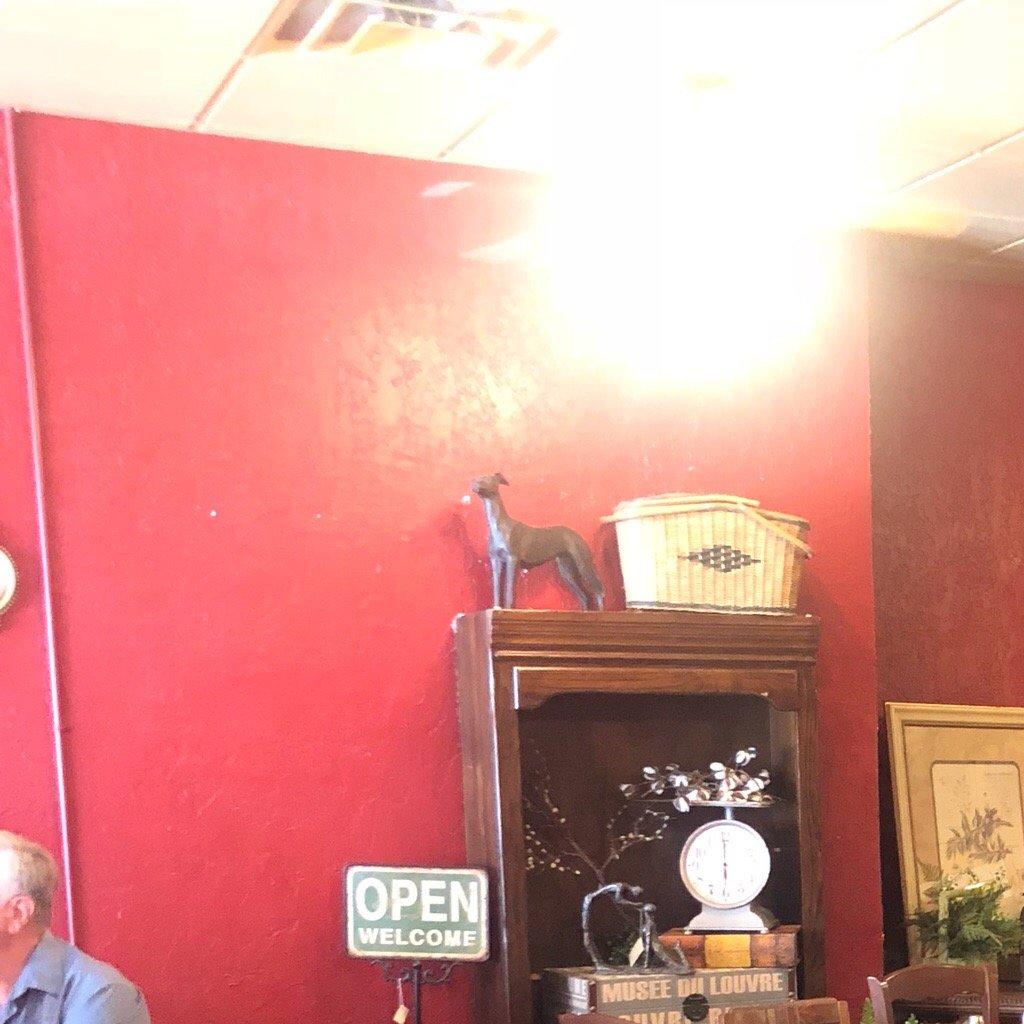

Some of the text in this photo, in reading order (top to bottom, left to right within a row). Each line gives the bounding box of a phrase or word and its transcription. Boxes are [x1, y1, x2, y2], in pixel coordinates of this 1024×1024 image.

[355, 877, 478, 923] OPEN
[358, 927, 477, 947] WELCOME
[602, 979, 672, 1003] MUSEE
[677, 976, 705, 998] DU
[709, 972, 784, 995] LOUVRE
